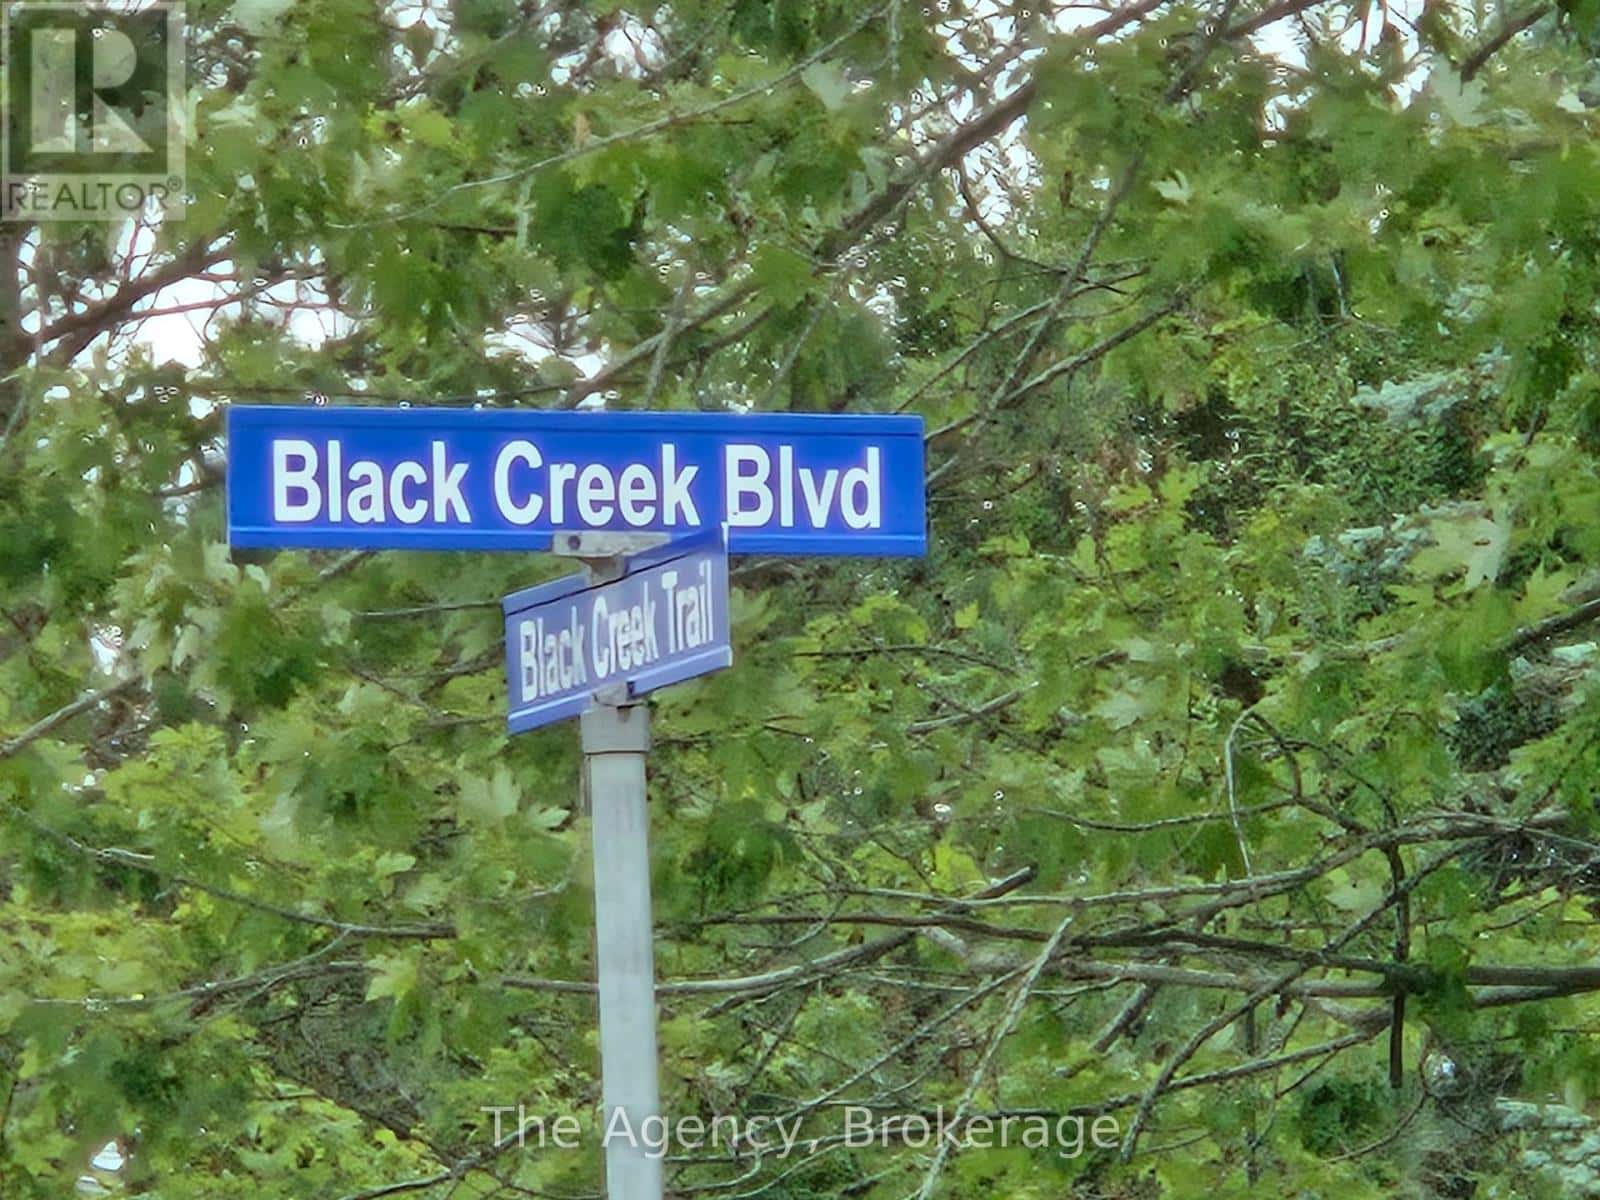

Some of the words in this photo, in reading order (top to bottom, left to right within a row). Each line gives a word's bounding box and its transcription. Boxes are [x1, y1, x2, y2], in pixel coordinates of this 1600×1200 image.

[271, 438, 472, 524] Black
[493, 440, 700, 526] Creek
[724, 444, 882, 529] Blvd
[519, 605, 587, 702] Black
[592, 580, 659, 679] Creek
[661, 559, 714, 654] Trail
